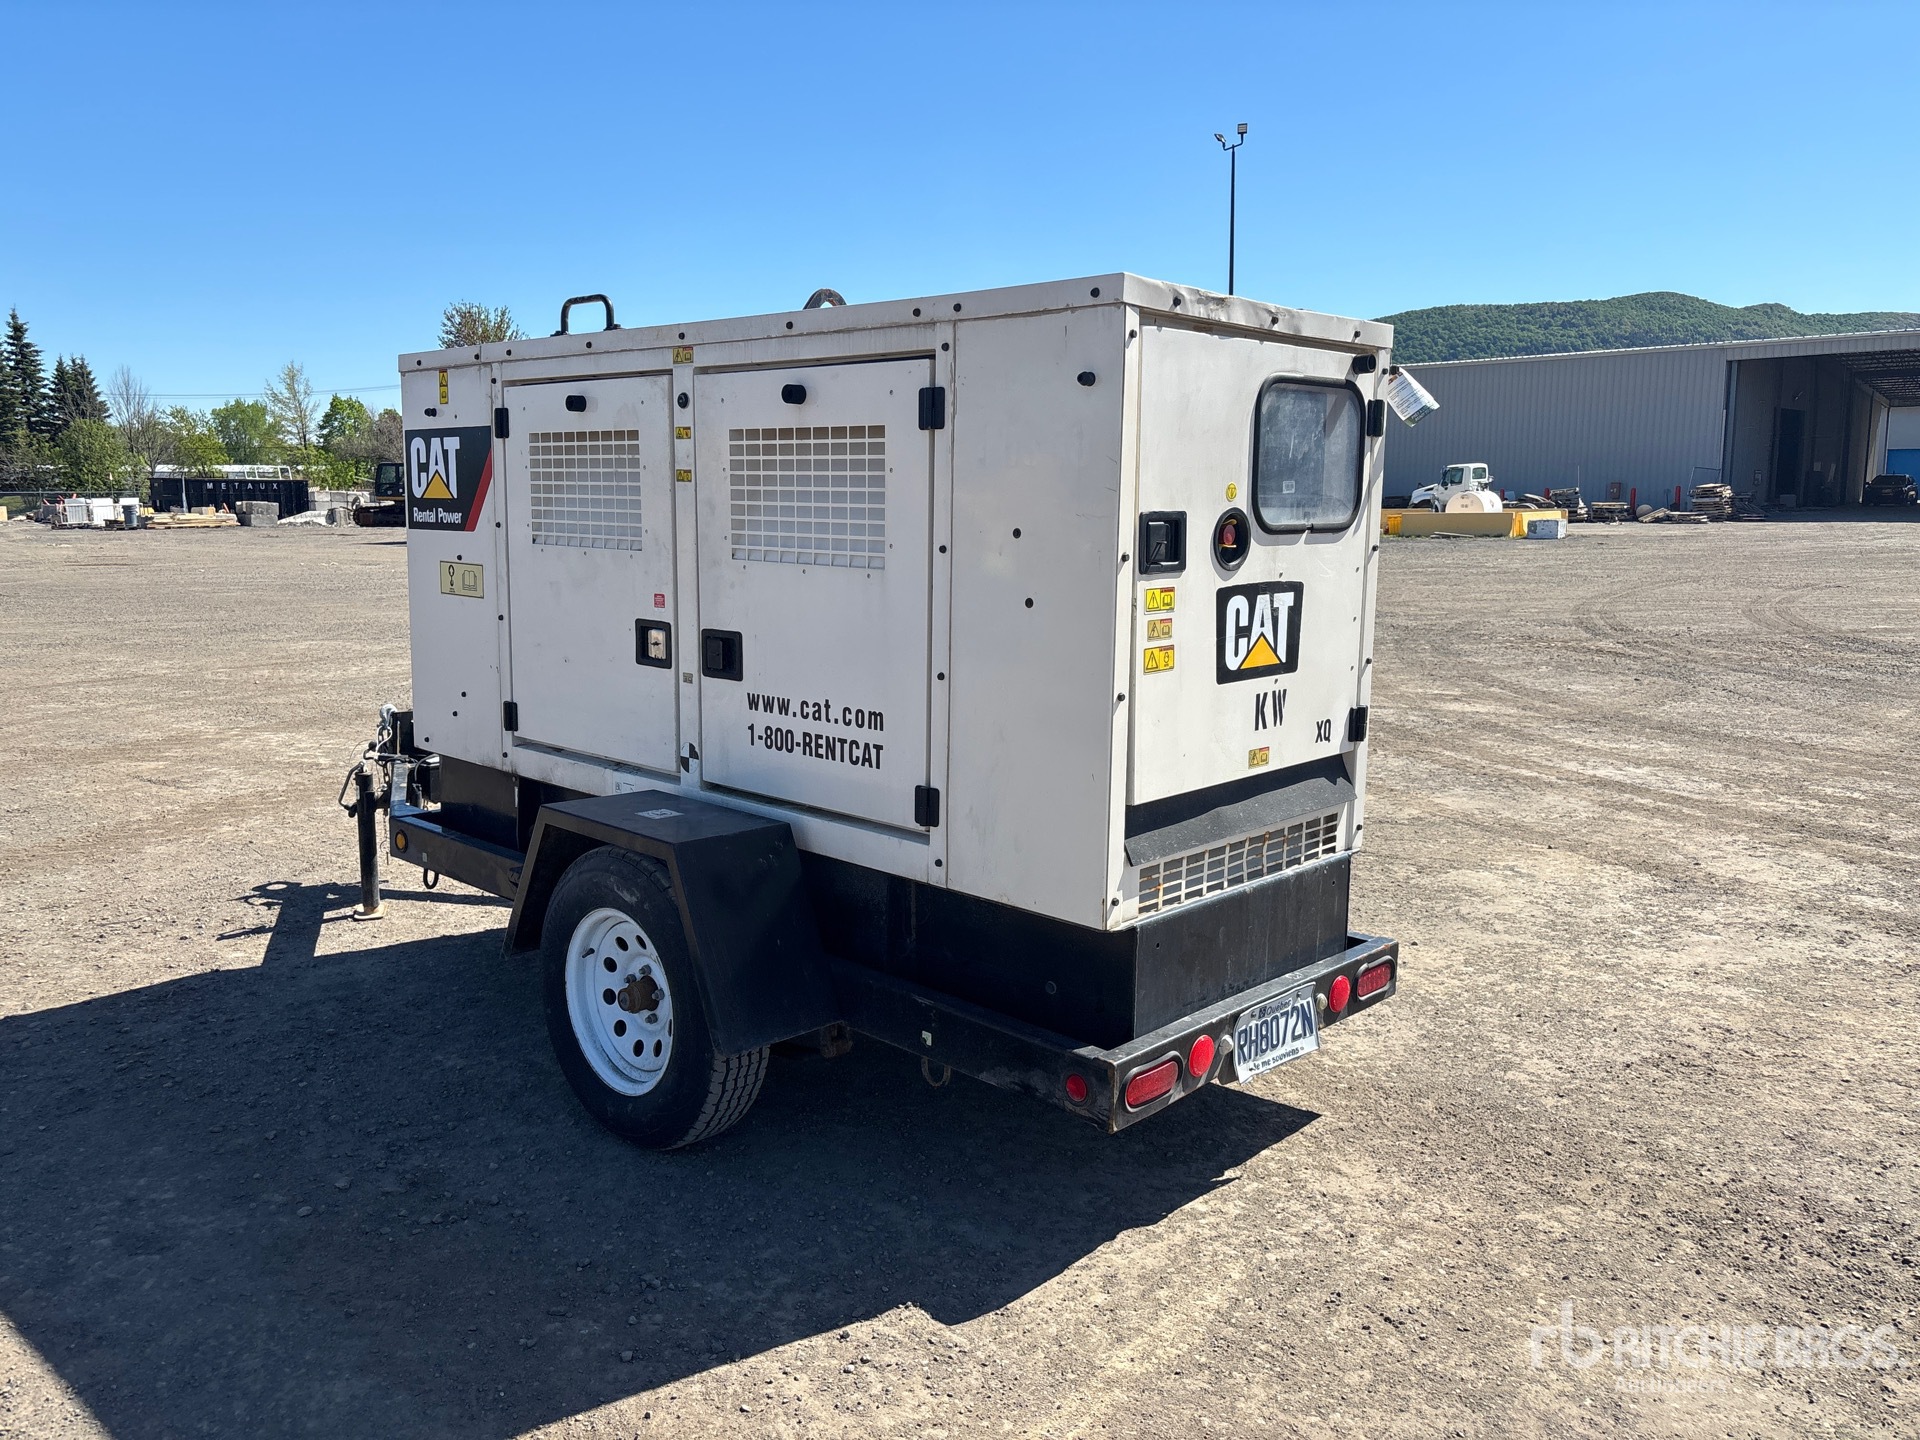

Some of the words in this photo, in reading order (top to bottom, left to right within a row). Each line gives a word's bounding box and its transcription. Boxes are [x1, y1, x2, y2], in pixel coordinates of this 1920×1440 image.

[206, 482, 278, 490] METAUX
[410, 436, 460, 498] CAT
[413, 507, 436, 522] Rental
[438, 507, 462, 524] Power
[1225, 592, 1294, 671] CAT
[747, 692, 884, 732] www.cat.com
[1254, 688, 1287, 731] KW
[1315, 718, 1332, 744] XQ
[747, 723, 884, 770] 1-800-RENTCAT
[1237, 1001, 1314, 1067] RH8072N
